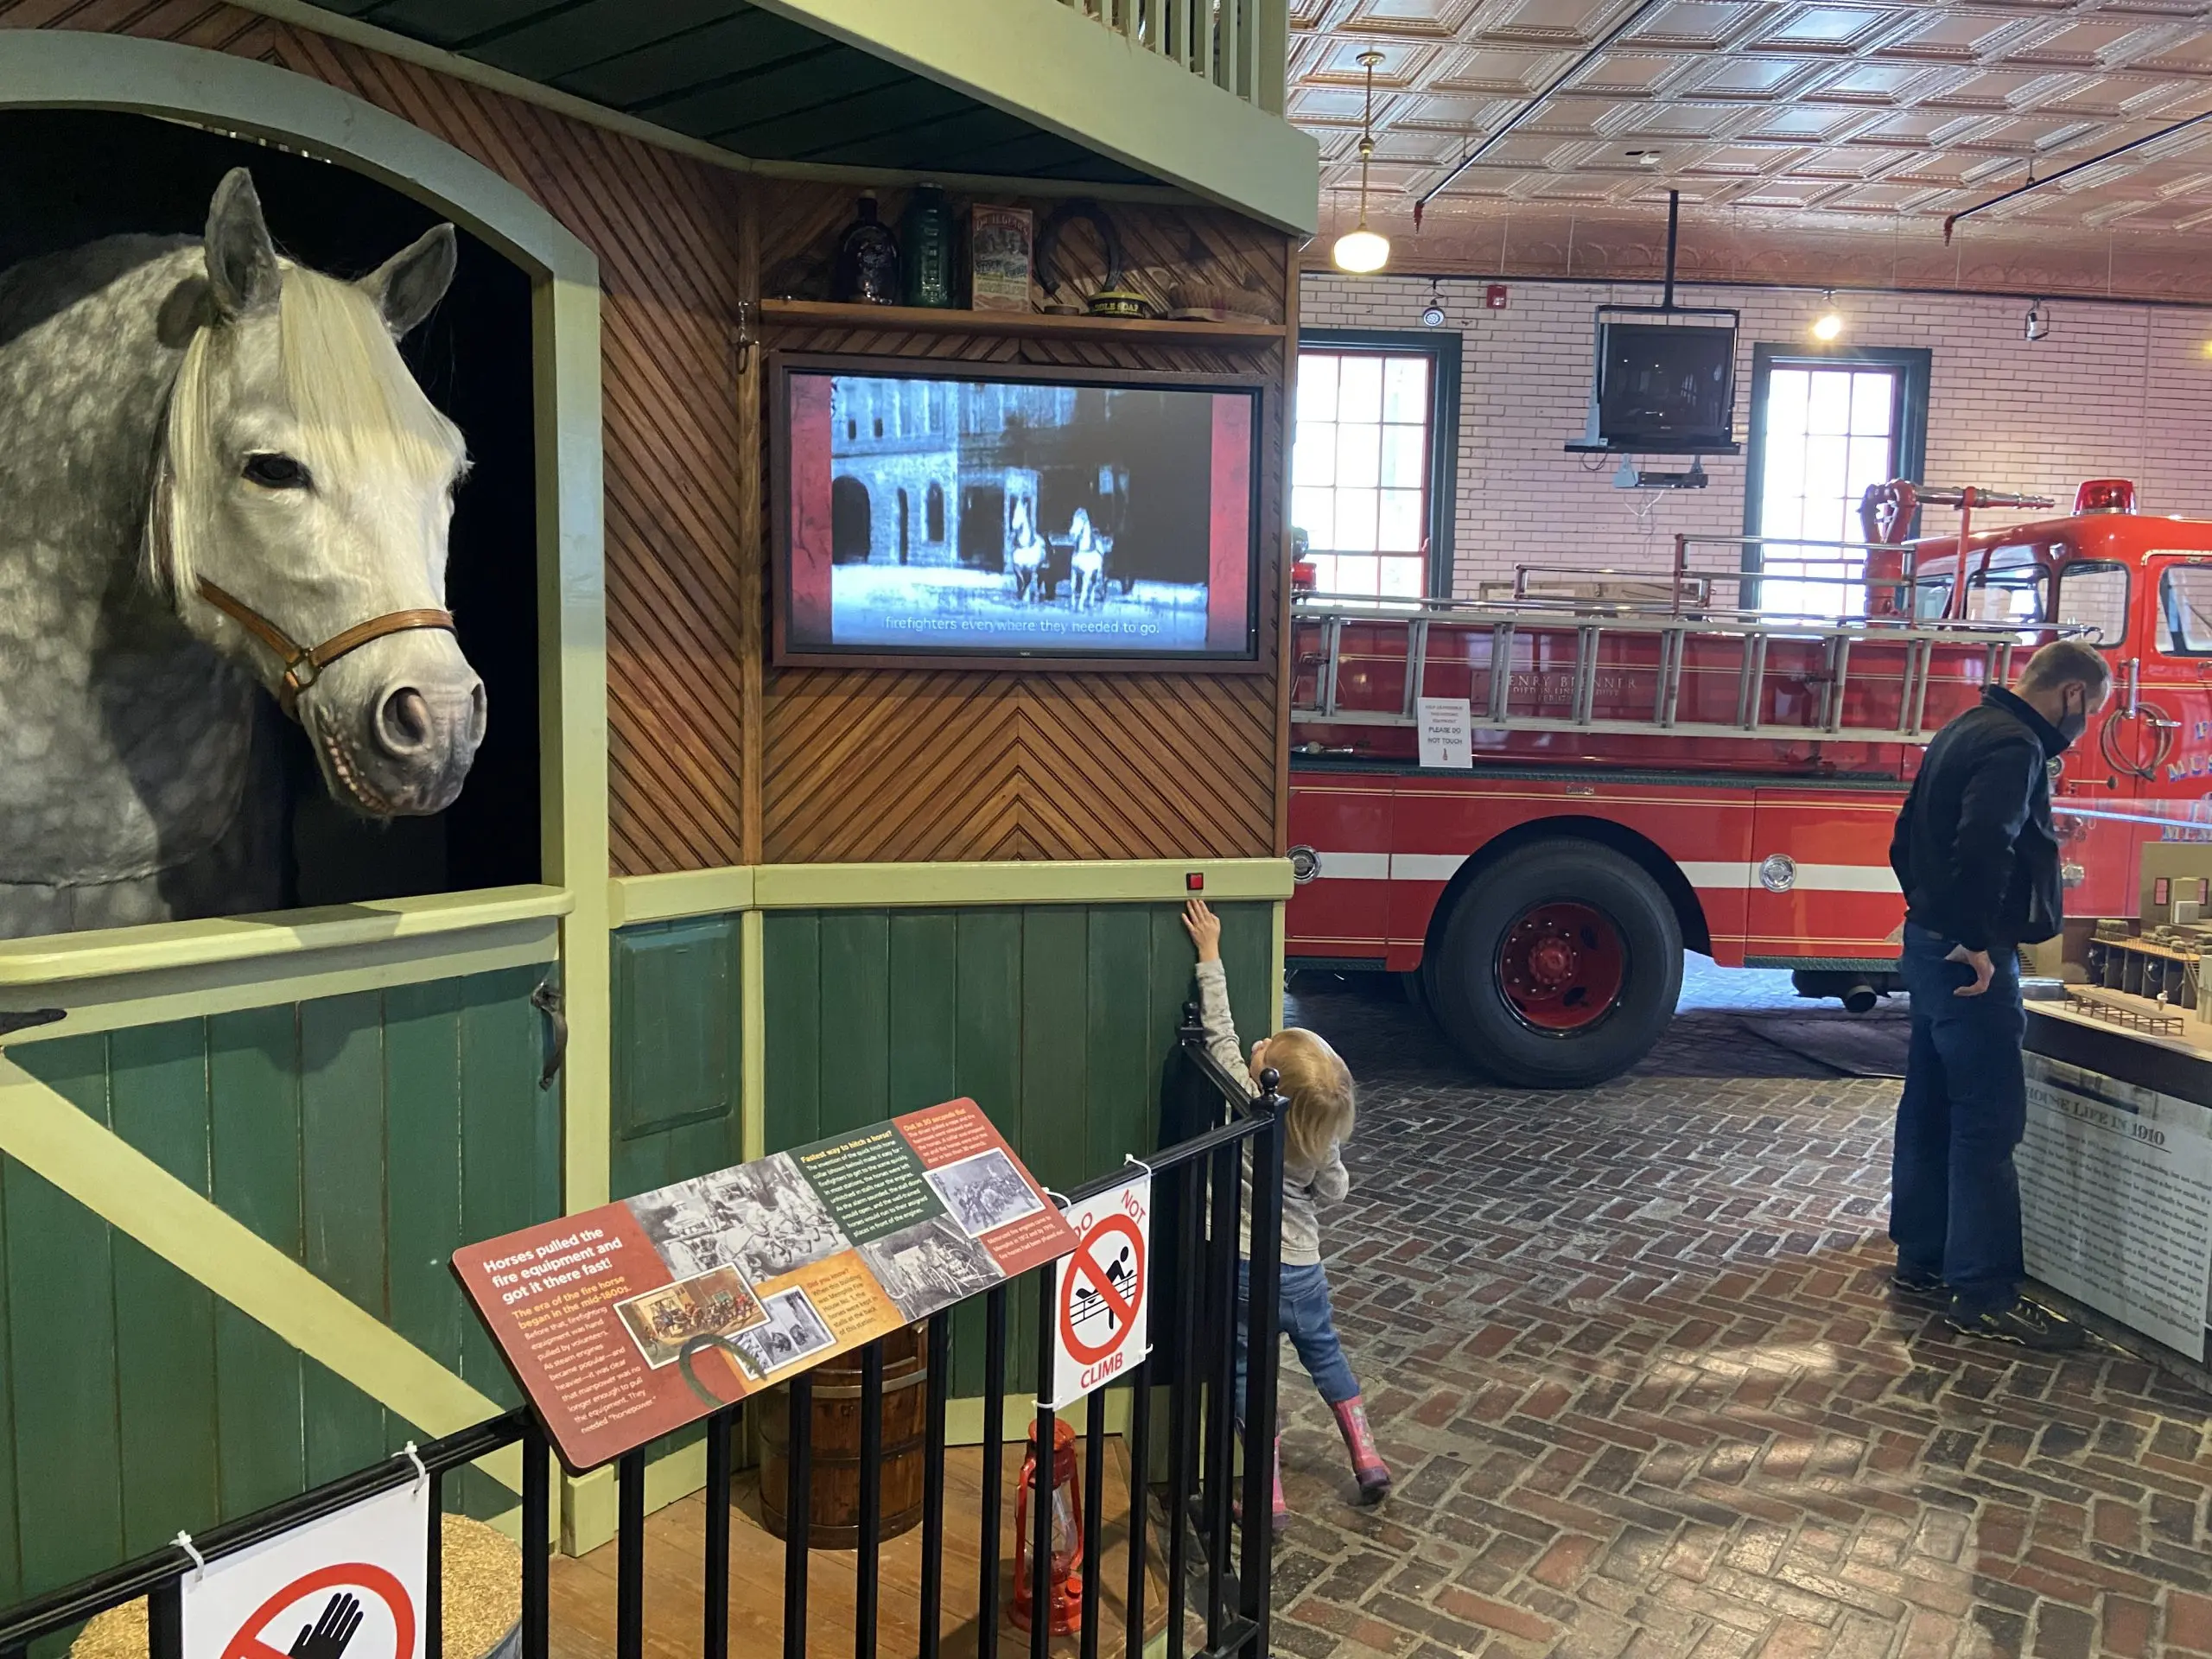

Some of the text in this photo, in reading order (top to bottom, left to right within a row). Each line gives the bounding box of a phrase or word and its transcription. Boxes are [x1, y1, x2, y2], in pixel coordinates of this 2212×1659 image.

[886, 616, 957, 632] firefighters
[1040, 619, 1067, 634] they
[1072, 620, 1119, 633] needed
[1123, 620, 1136, 632] to
[1140, 623, 1160, 636] go.
[1509, 675, 1551, 687] ENRY
[800, 1151, 826, 1163] Fastest
[848, 1139, 866, 1147] hitch
[870, 1129, 892, 1141] horse?
[2132, 1123, 2165, 1146] 1910
[1122, 1189, 1147, 1224] NOT
[483, 1229, 603, 1272] Horses pulled the
[492, 1236, 622, 1287] fire equipment and
[502, 1257, 612, 1304] got it there fast!
[511, 1276, 624, 1319] The era of the fire horse
[518, 1313, 550, 1329] began
[562, 1303, 579, 1313] the
[581, 1286, 631, 1306] mid-1800s.
[531, 1318, 604, 1349] equipment was hand
[537, 1346, 560, 1361] pulled
[570, 1330, 608, 1346] volunteers.
[553, 1354, 575, 1366] steam
[575, 1344, 603, 1357] engines
[1080, 1351, 1123, 1389] CLIMB
[562, 1391, 578, 1402] that
[578, 1376, 615, 1395] manpower
[616, 1370, 631, 1379] was
[567, 1398, 591, 1411] longer
[593, 1387, 620, 1402] enough
[629, 1376, 643, 1388] pull
